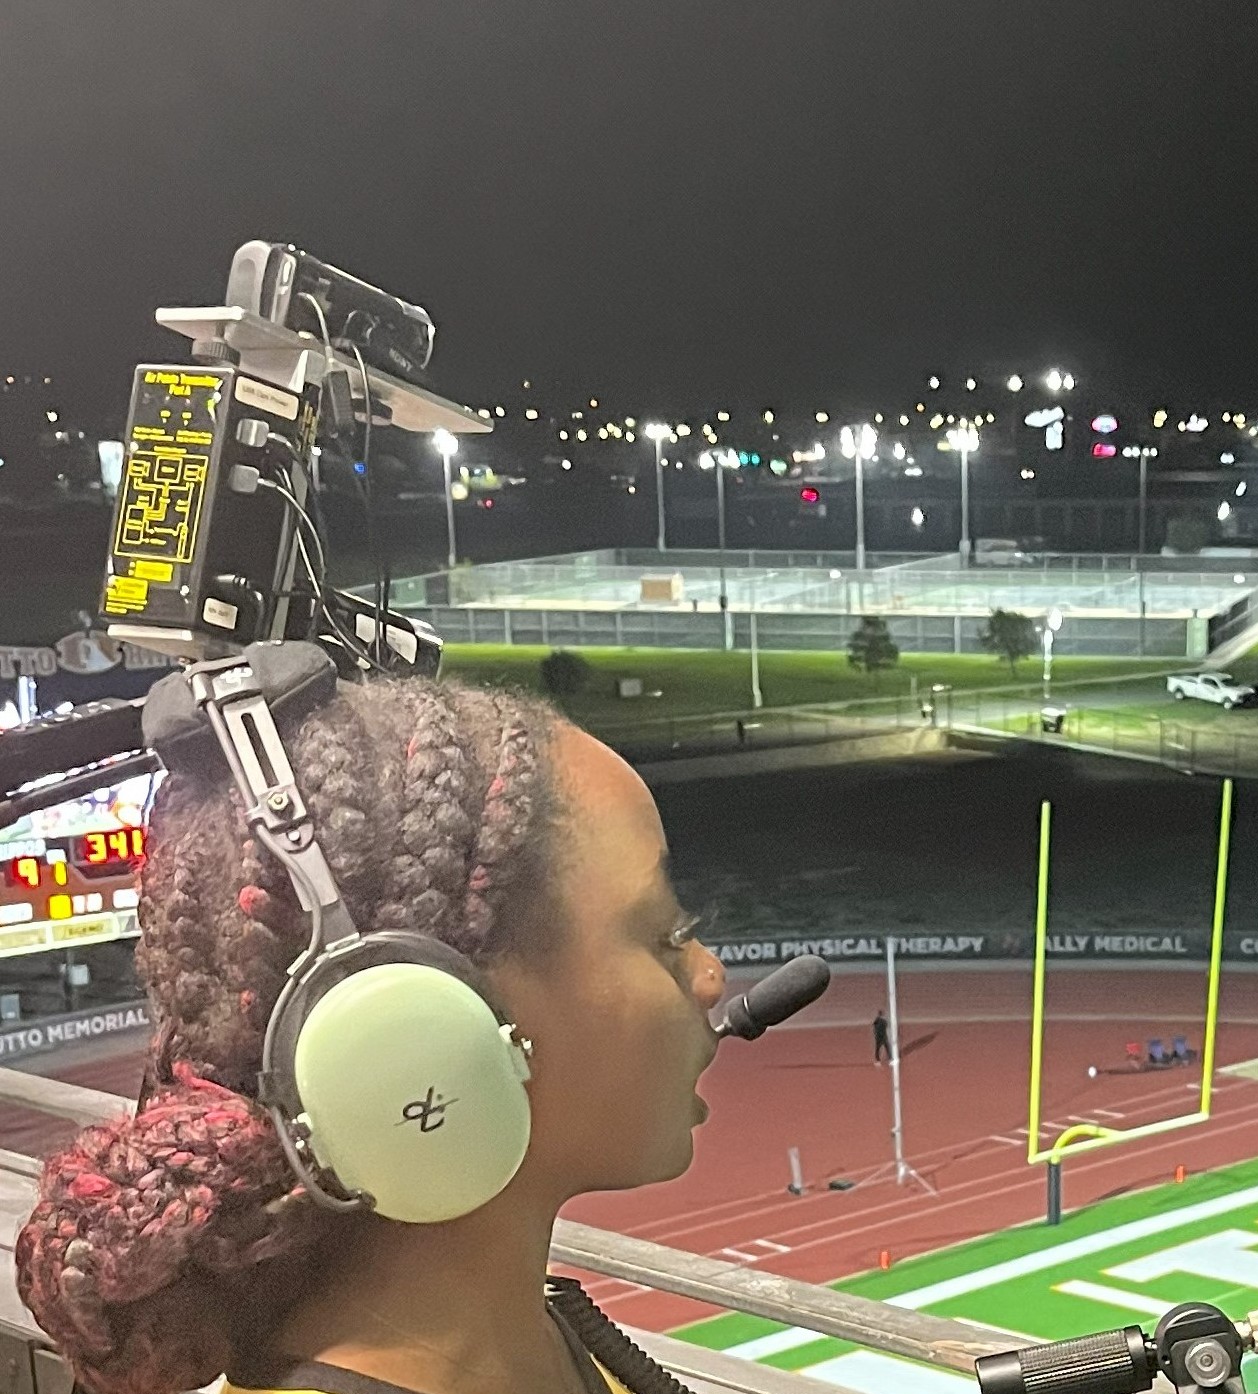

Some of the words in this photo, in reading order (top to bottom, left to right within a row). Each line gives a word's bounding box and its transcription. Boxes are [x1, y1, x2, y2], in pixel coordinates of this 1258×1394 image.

[781, 938, 882, 959] PHYSICAL
[1094, 934, 1188, 953] MEDICAL
[46, 1007, 150, 1043] MEMORIAL
